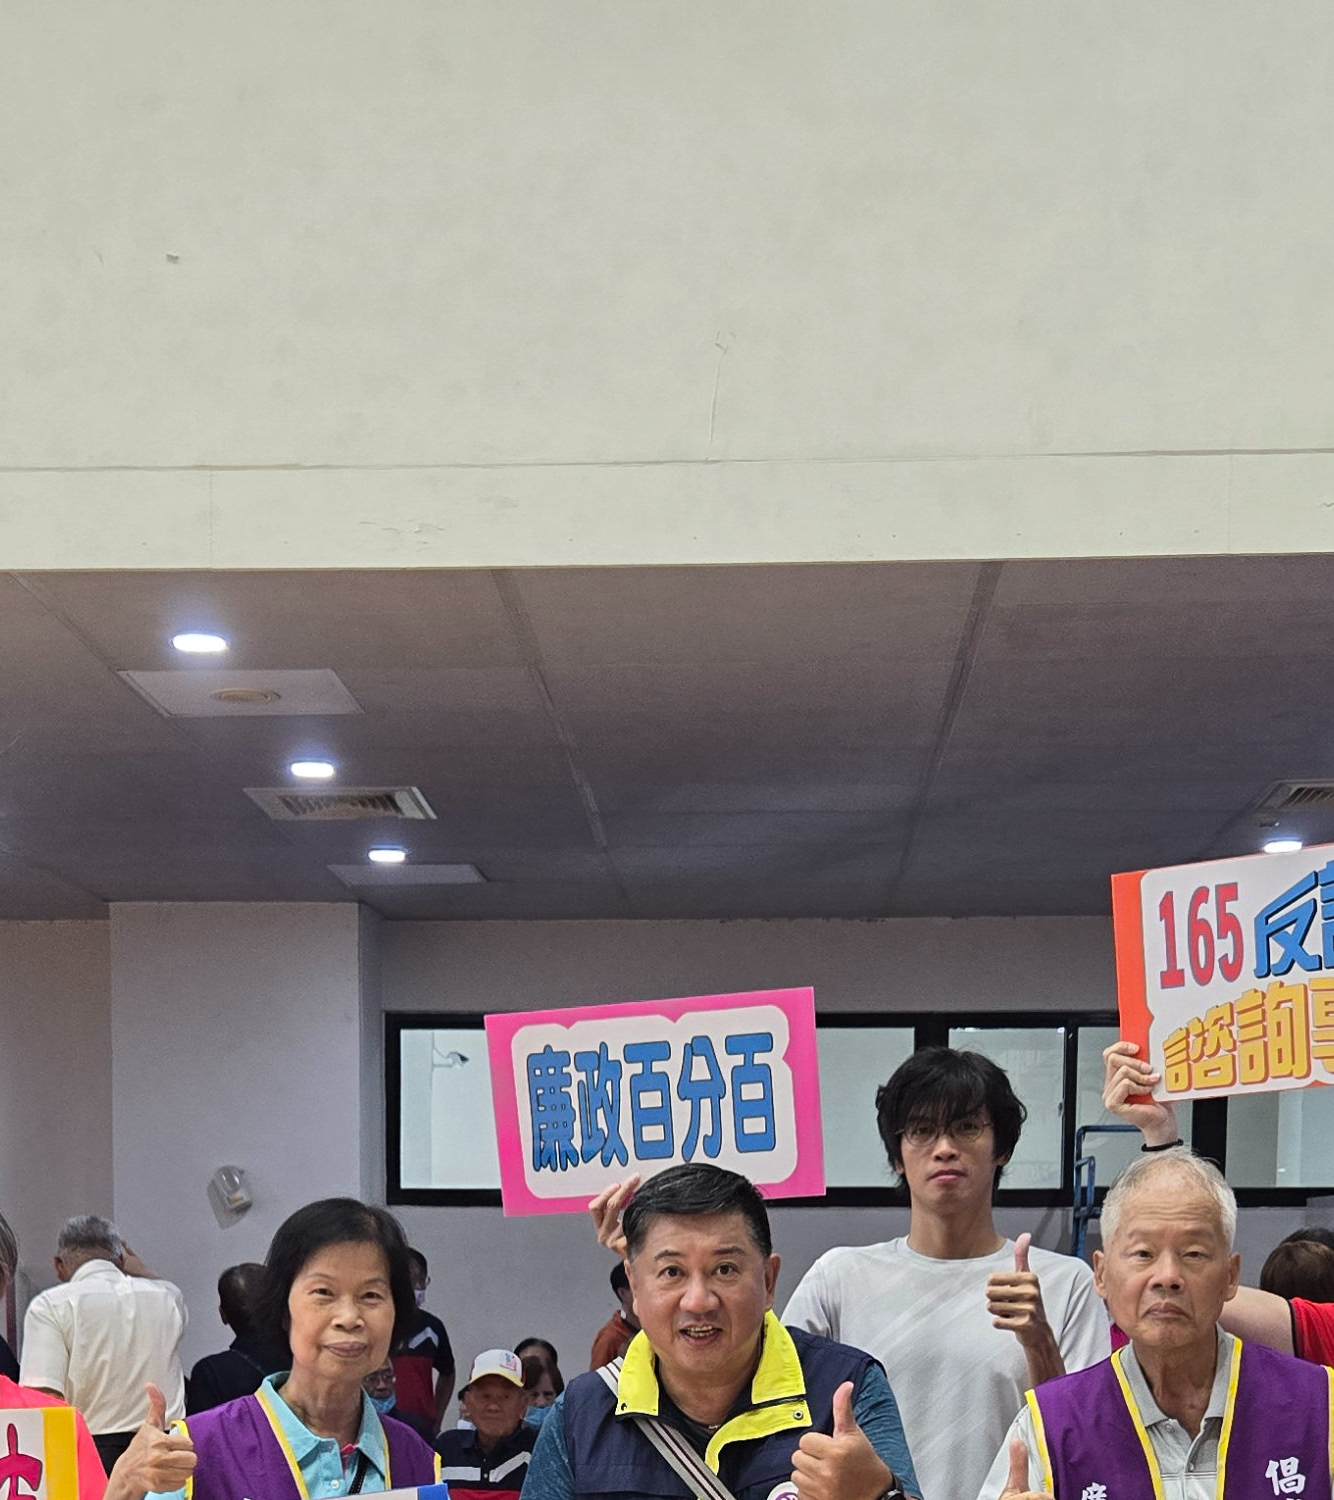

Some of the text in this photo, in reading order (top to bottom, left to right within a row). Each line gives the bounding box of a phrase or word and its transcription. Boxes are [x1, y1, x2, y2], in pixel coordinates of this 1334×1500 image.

[1159, 882, 1244, 990] 165
[526, 1031, 777, 1173] 廉政百分百
